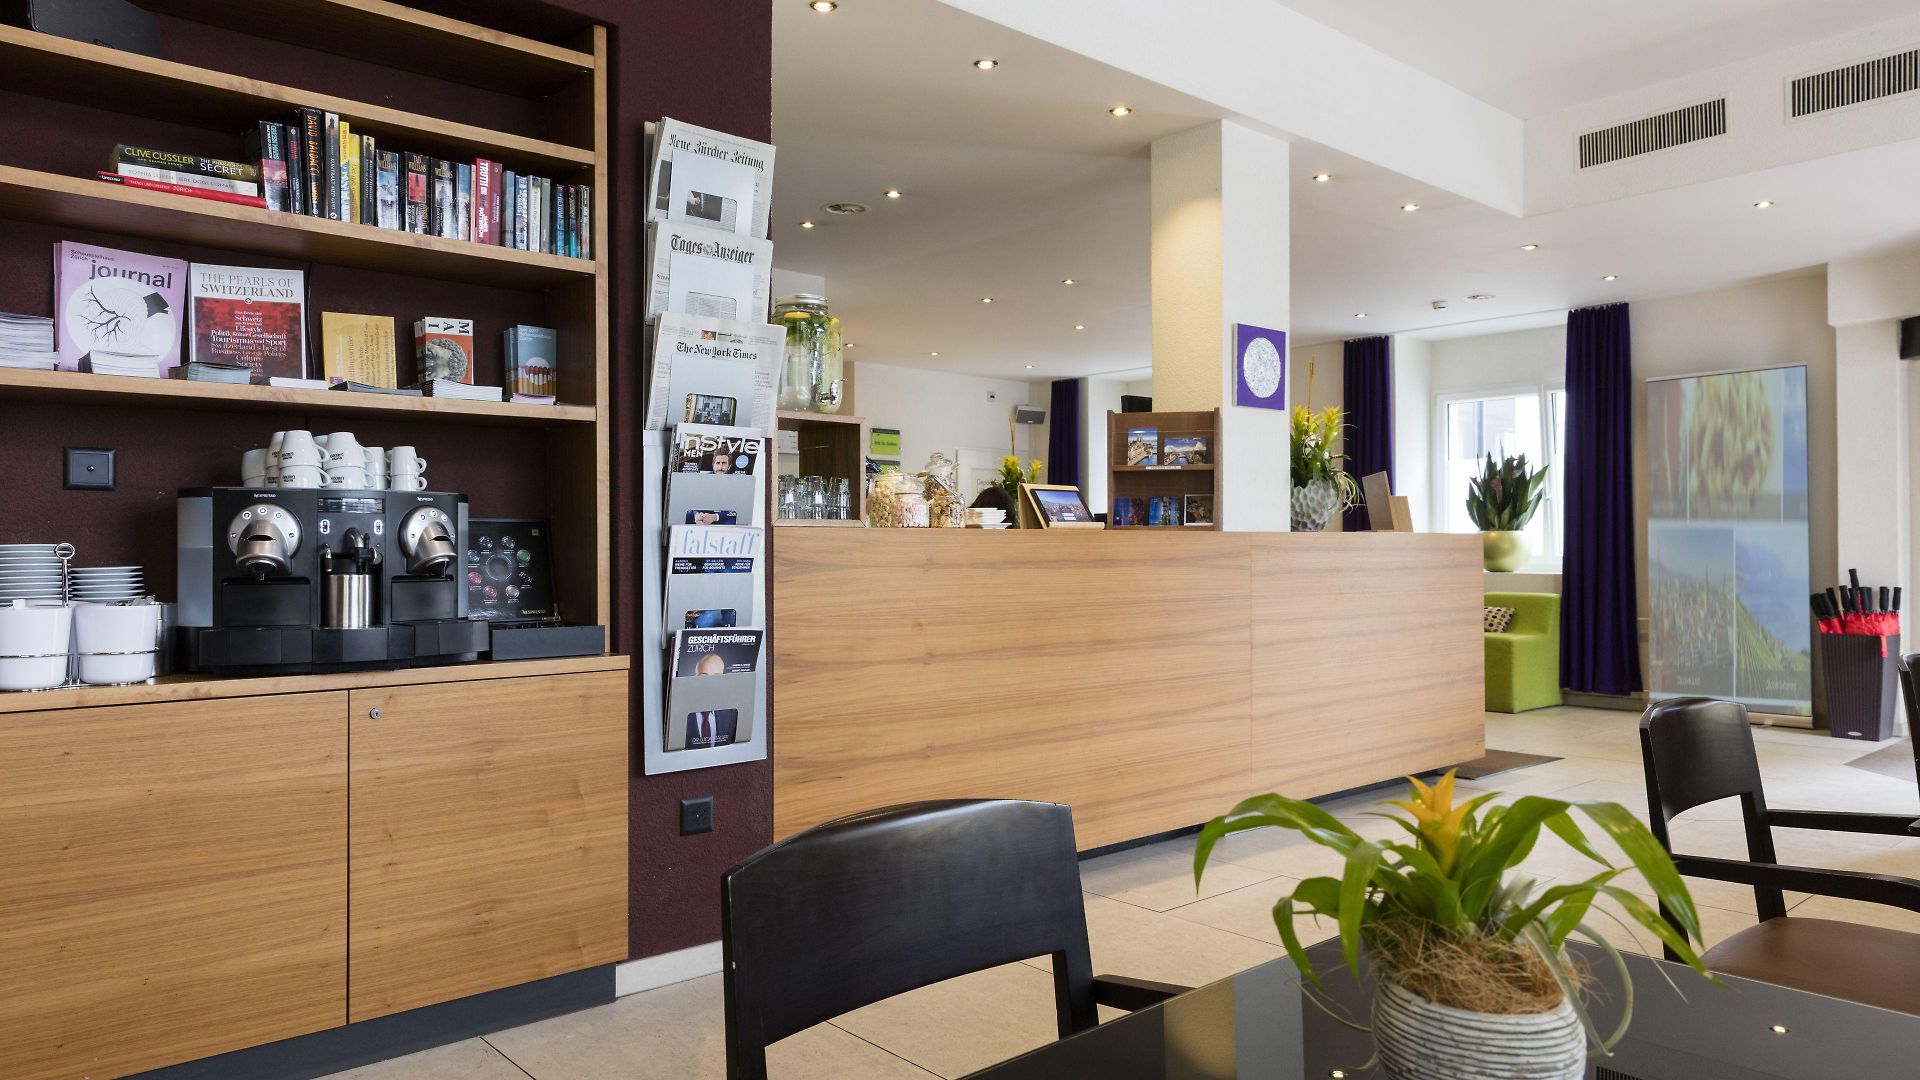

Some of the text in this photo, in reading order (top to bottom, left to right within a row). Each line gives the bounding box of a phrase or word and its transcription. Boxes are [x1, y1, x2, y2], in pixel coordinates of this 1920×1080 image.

[307, 115, 318, 136] DAVID
[124, 147, 194, 165] CLIVE CUSSLER
[669, 133, 764, 172] Neue Zürcher Zeitung
[200, 163, 244, 176] SECRET
[480, 162, 488, 186] TRUTH
[671, 234, 754, 263] Tages Anzeiger
[89, 260, 172, 288] journal
[200, 272, 293, 288] THE PEARLS OF
[201, 283, 294, 298] SWITZERLAND
[211, 335, 254, 344] Tourismus
[676, 342, 757, 359] The New York Times
[684, 449, 703, 458] MEN
[683, 529, 760, 554] falstaff
[688, 634, 756, 644] GESCHÄFTSFÜHRER
[687, 643, 715, 653] ZÜRICH
